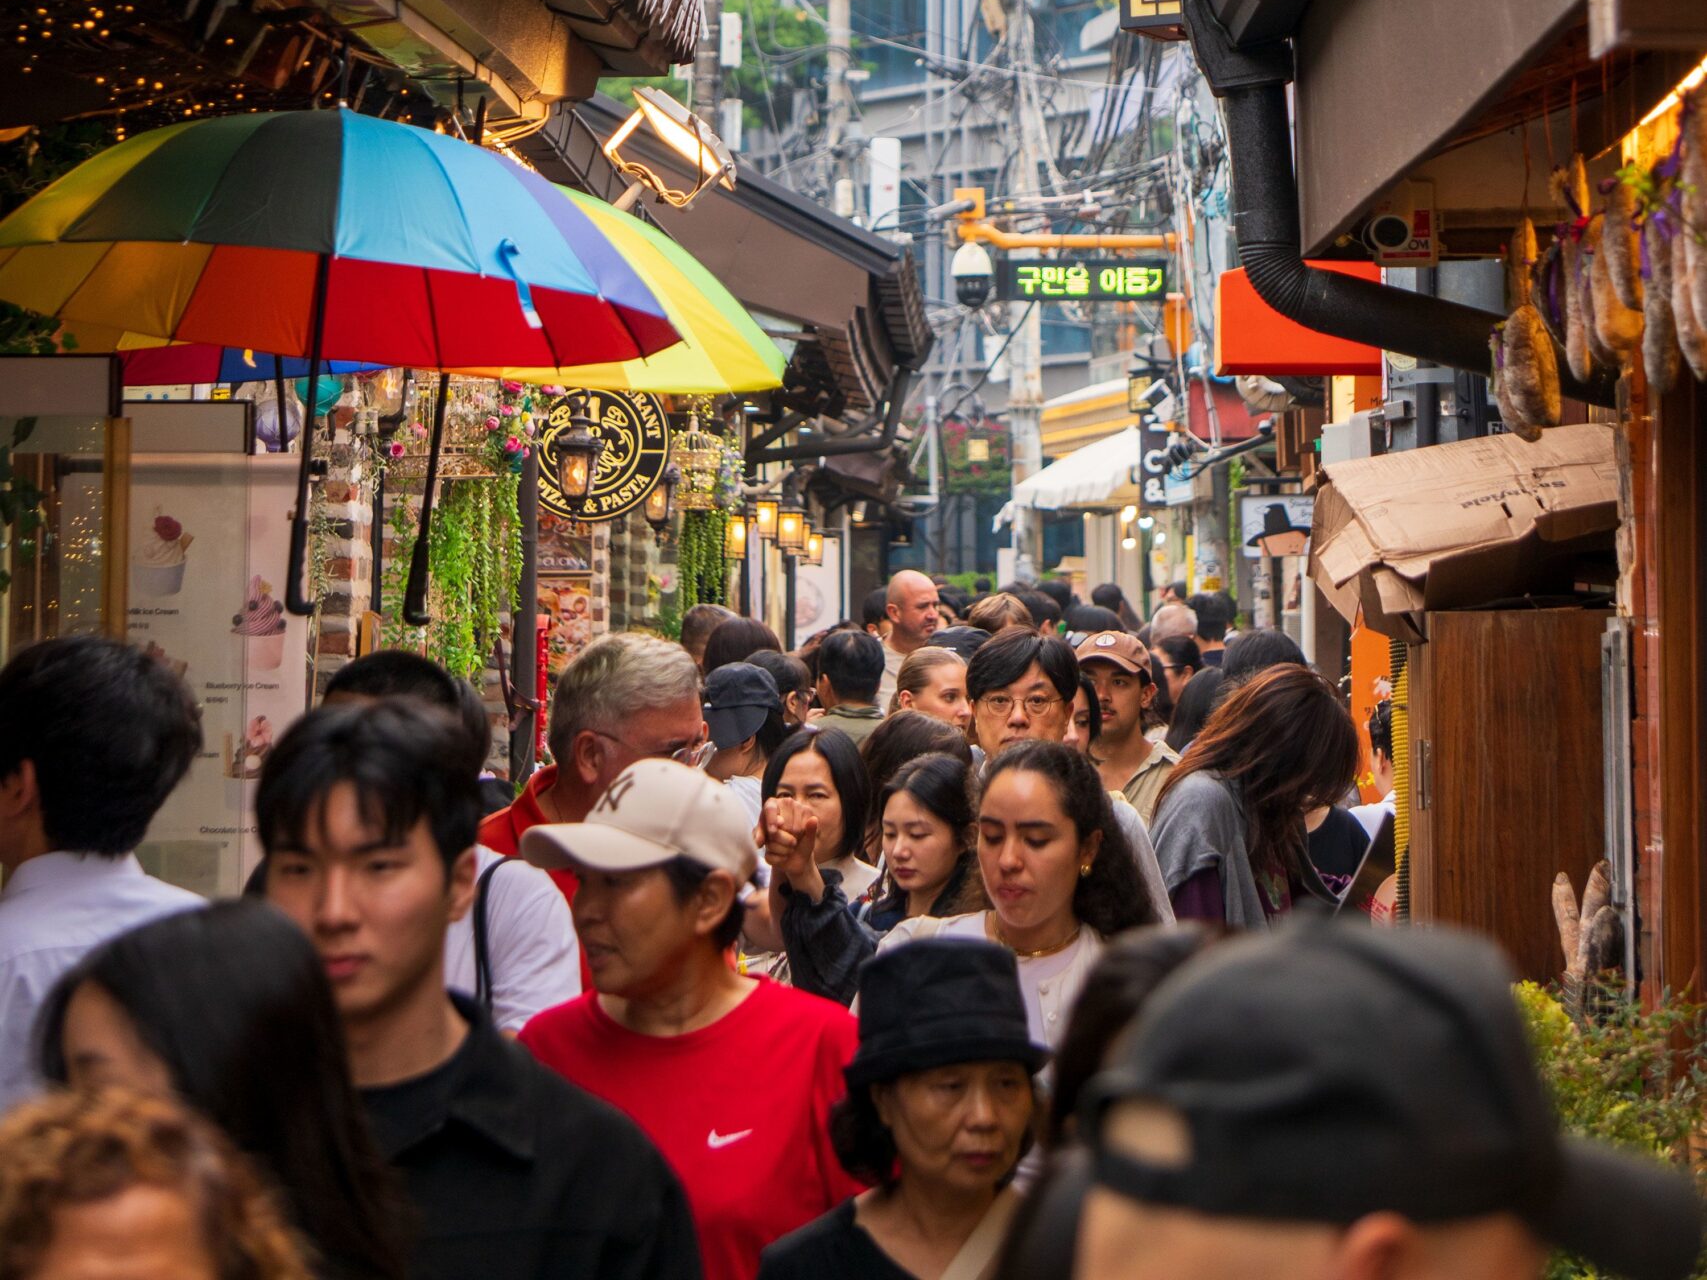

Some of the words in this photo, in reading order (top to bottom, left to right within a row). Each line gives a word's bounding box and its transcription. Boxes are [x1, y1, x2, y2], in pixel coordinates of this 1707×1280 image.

[1017, 266, 1091, 295] 구민을
[537, 476, 580, 512] PIZ
[583, 498, 598, 513] &
[599, 473, 651, 512] PASTA
